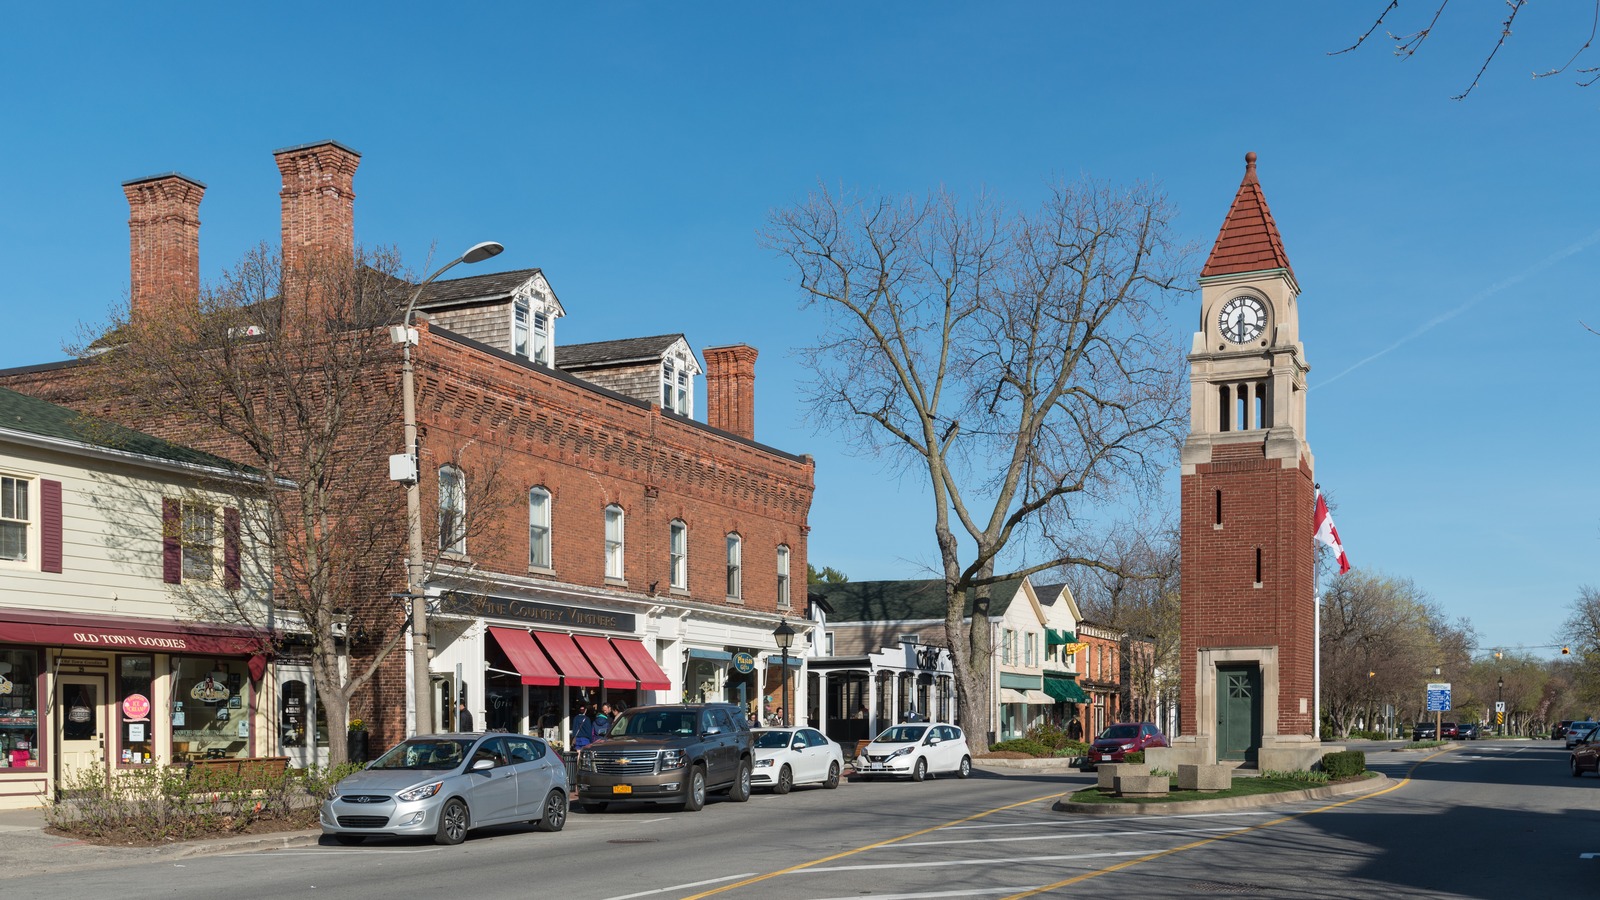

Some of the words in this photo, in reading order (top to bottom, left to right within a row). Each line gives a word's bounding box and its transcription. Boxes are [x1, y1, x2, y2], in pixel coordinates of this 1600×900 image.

[509, 601, 563, 621] COUNTRY
[568, 607, 616, 627] VINTNERS
[74, 632, 98, 642] OLD
[100, 634, 136, 644] TOWN
[138, 637, 186, 648] GOODIES
